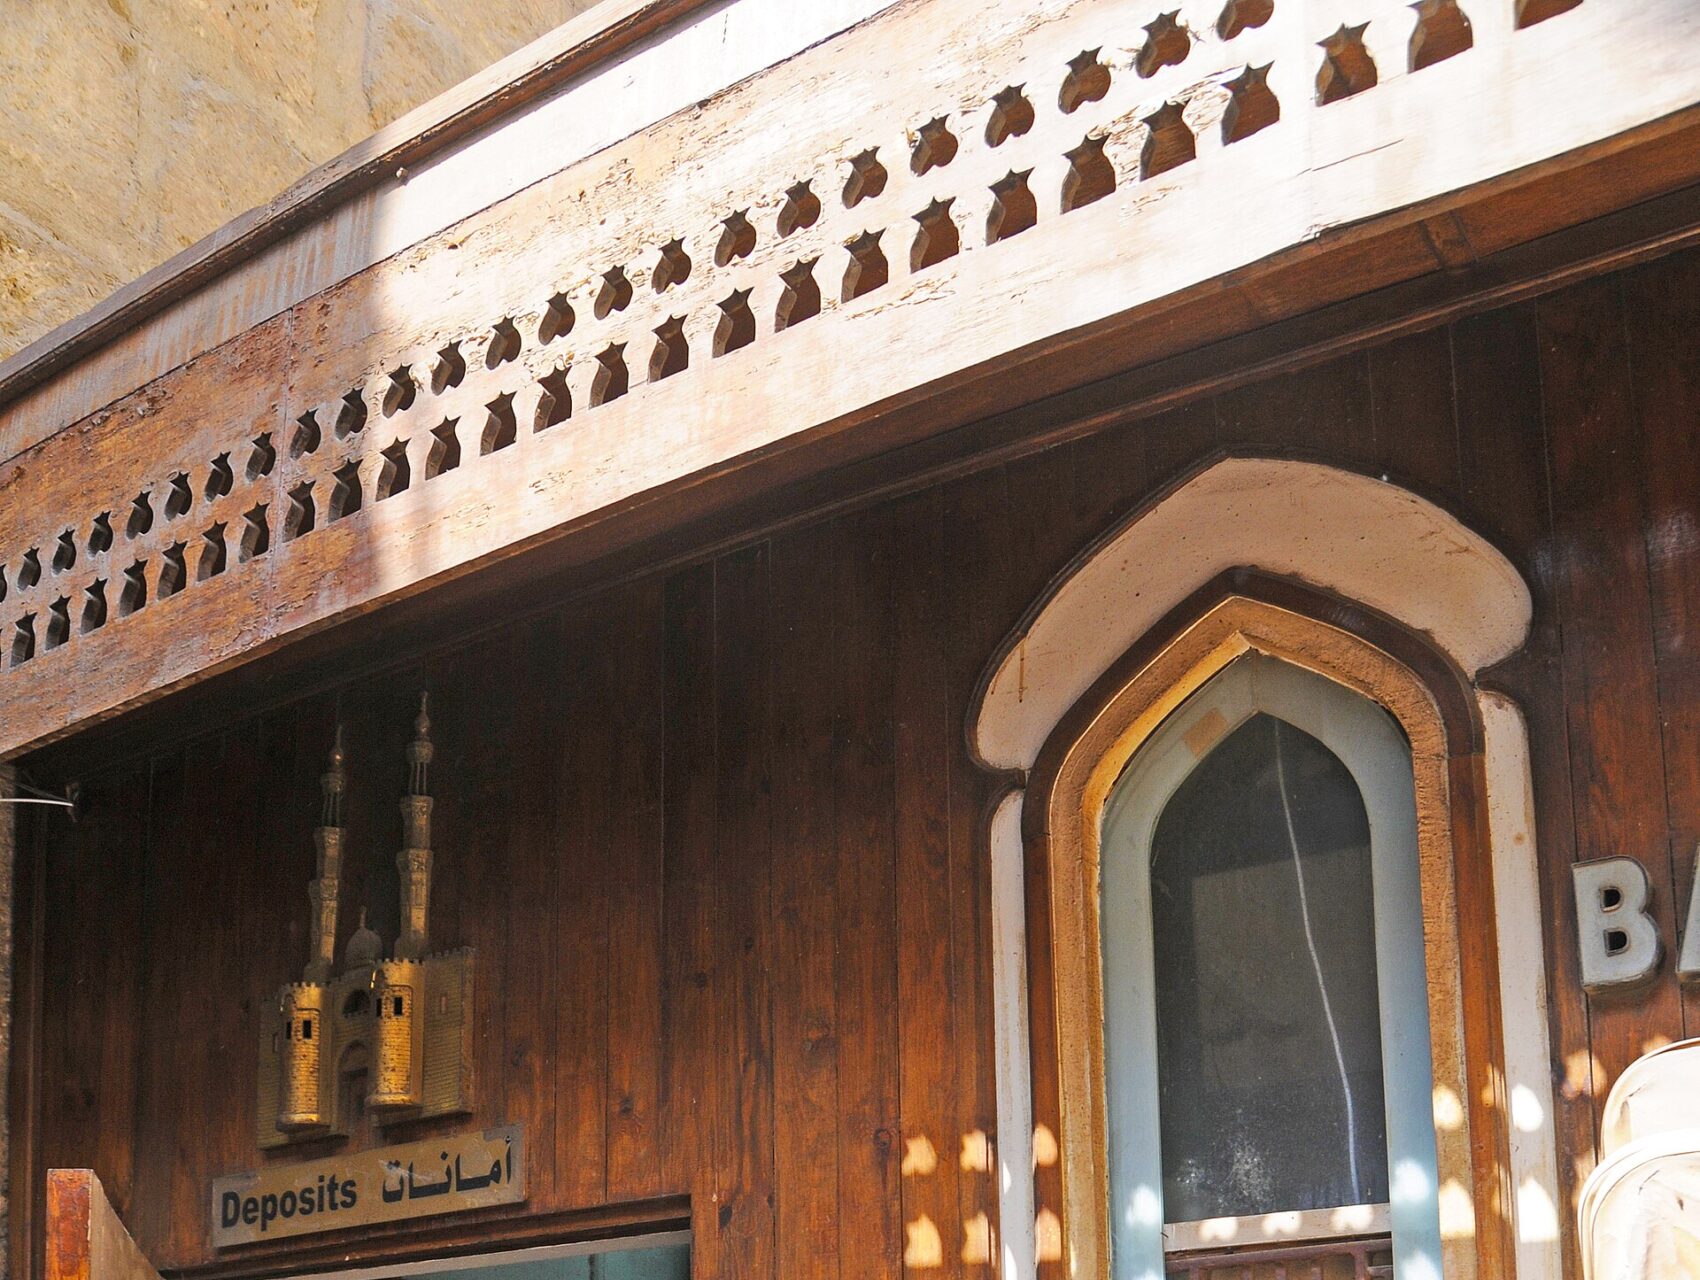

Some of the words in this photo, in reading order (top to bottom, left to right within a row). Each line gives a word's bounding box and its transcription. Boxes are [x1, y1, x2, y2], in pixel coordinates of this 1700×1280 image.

[1571, 843, 1700, 985] B
[221, 1174, 357, 1231] Deposits
[381, 1135, 513, 1203] أمانات
